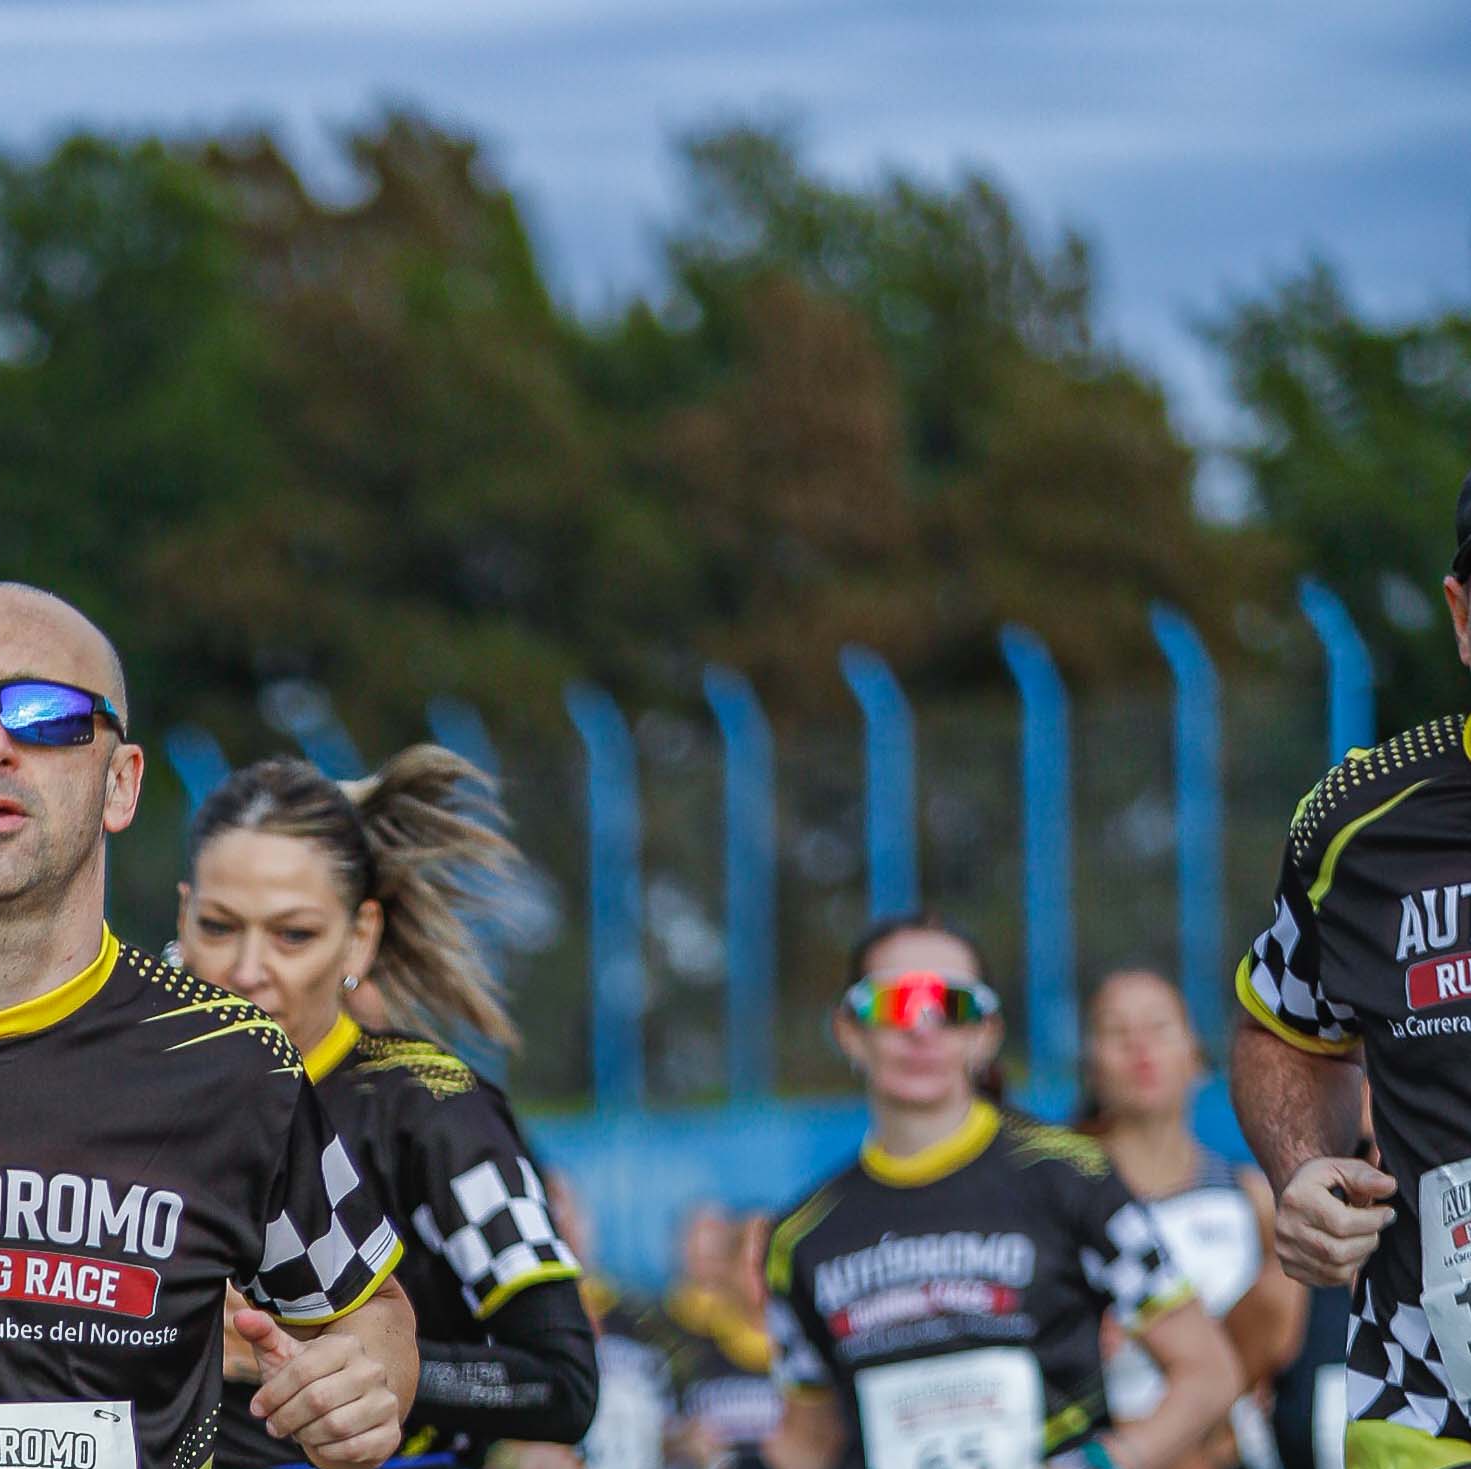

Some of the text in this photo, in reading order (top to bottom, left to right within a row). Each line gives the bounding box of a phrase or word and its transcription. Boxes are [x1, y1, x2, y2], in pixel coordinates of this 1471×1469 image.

[1406, 1016, 1471, 1037] Carrera
[25, 1257, 120, 1307] RACE
[50, 1320, 84, 1343] del
[90, 1323, 178, 1345] Noroeste
